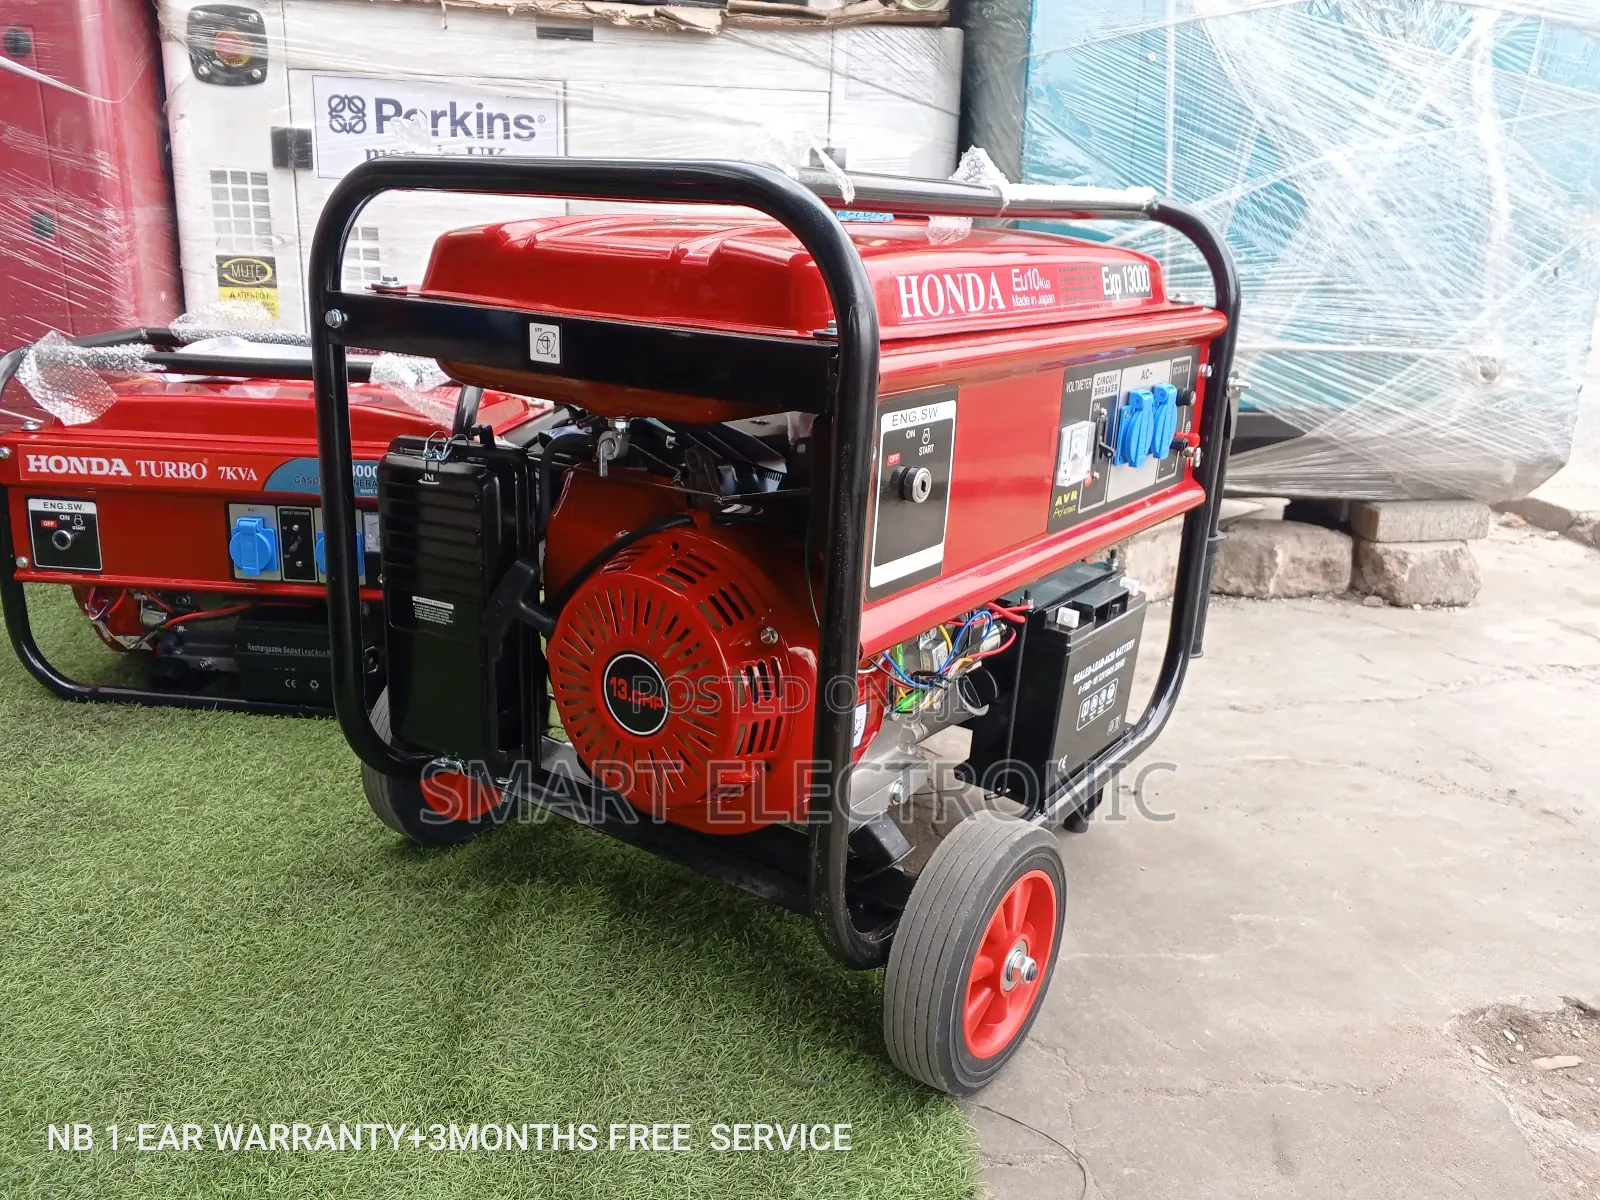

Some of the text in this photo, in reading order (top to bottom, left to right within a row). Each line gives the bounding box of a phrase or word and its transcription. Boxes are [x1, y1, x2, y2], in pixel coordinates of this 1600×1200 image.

[231, 264, 263, 278] MUTE
[896, 271, 1006, 318] HONDA
[1101, 268, 1122, 299] Exp
[1122, 264, 1150, 294] 13000
[1011, 293, 1056, 307] Made in Japan
[1066, 378, 1092, 393] VOLTMETER
[1096, 374, 1118, 386] CIRCUIT
[1094, 384, 1118, 396] BREAKER
[1093, 402, 1101, 411] ON
[906, 429, 916, 439] ON
[918, 444, 935, 456] START
[889, 454, 900, 464] OFF
[26, 454, 258, 481] HONDA TURBO 7KVA
[1055, 490, 1078, 506] AVR
[247, 643, 283, 654] Rechargeable
